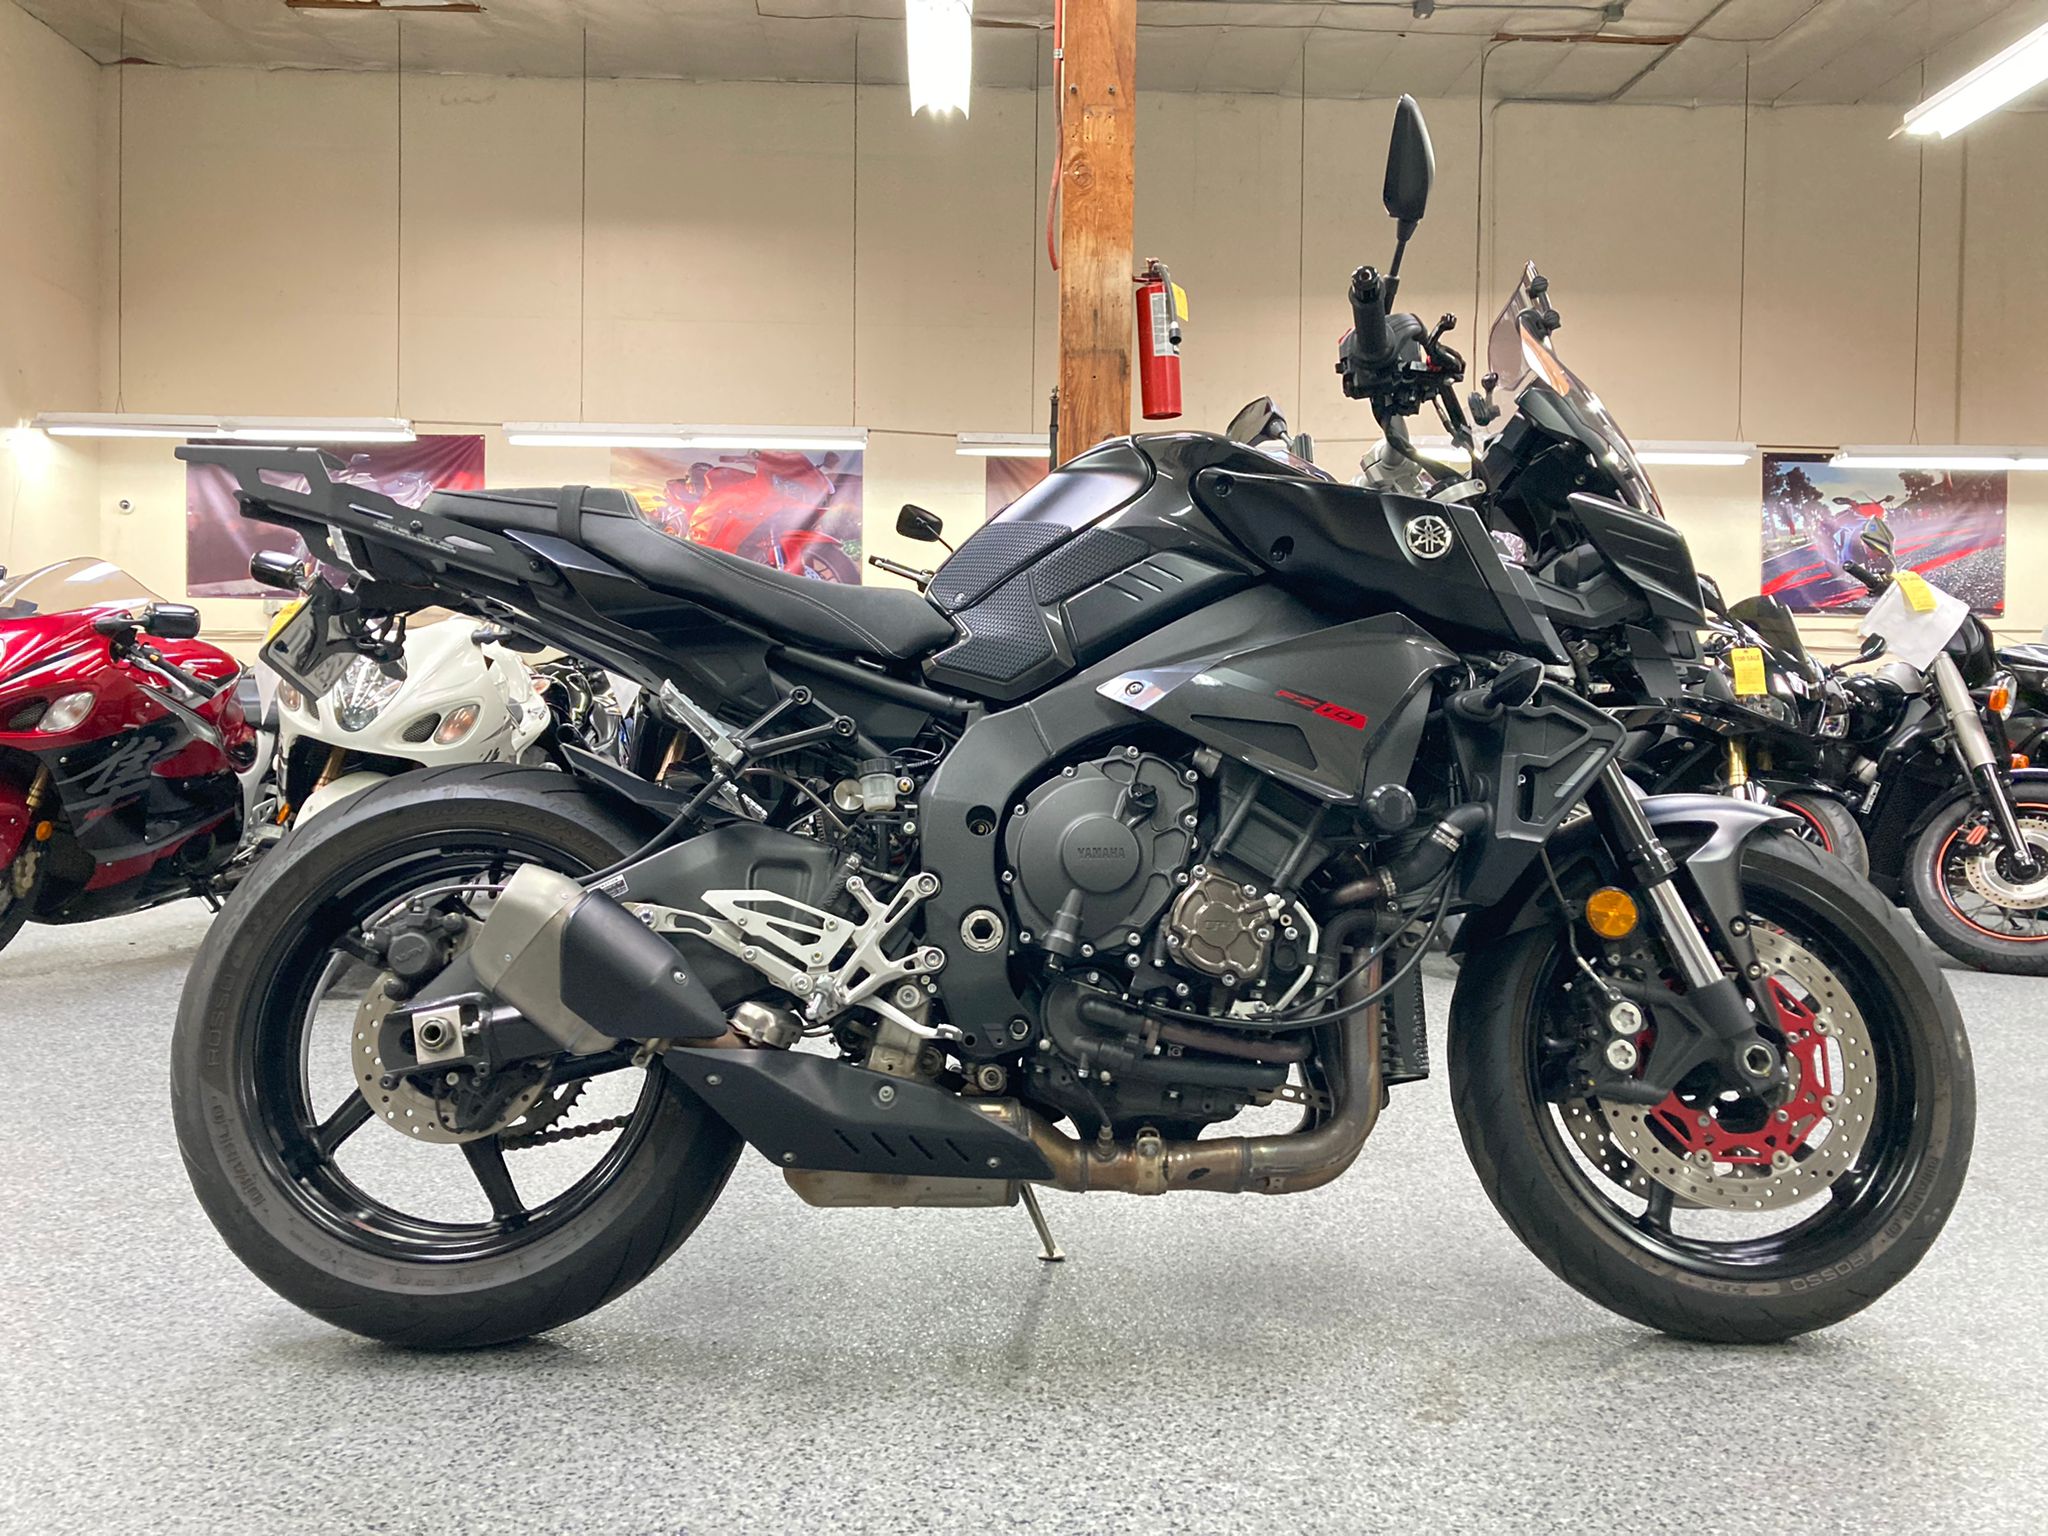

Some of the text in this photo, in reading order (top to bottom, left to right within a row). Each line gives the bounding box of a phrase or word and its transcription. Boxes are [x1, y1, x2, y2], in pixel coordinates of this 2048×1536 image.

[1077, 847, 1126, 859] YAMAHA
[207, 974, 236, 1068] ROSSO
[1790, 1253, 1867, 1292] ROSSO
